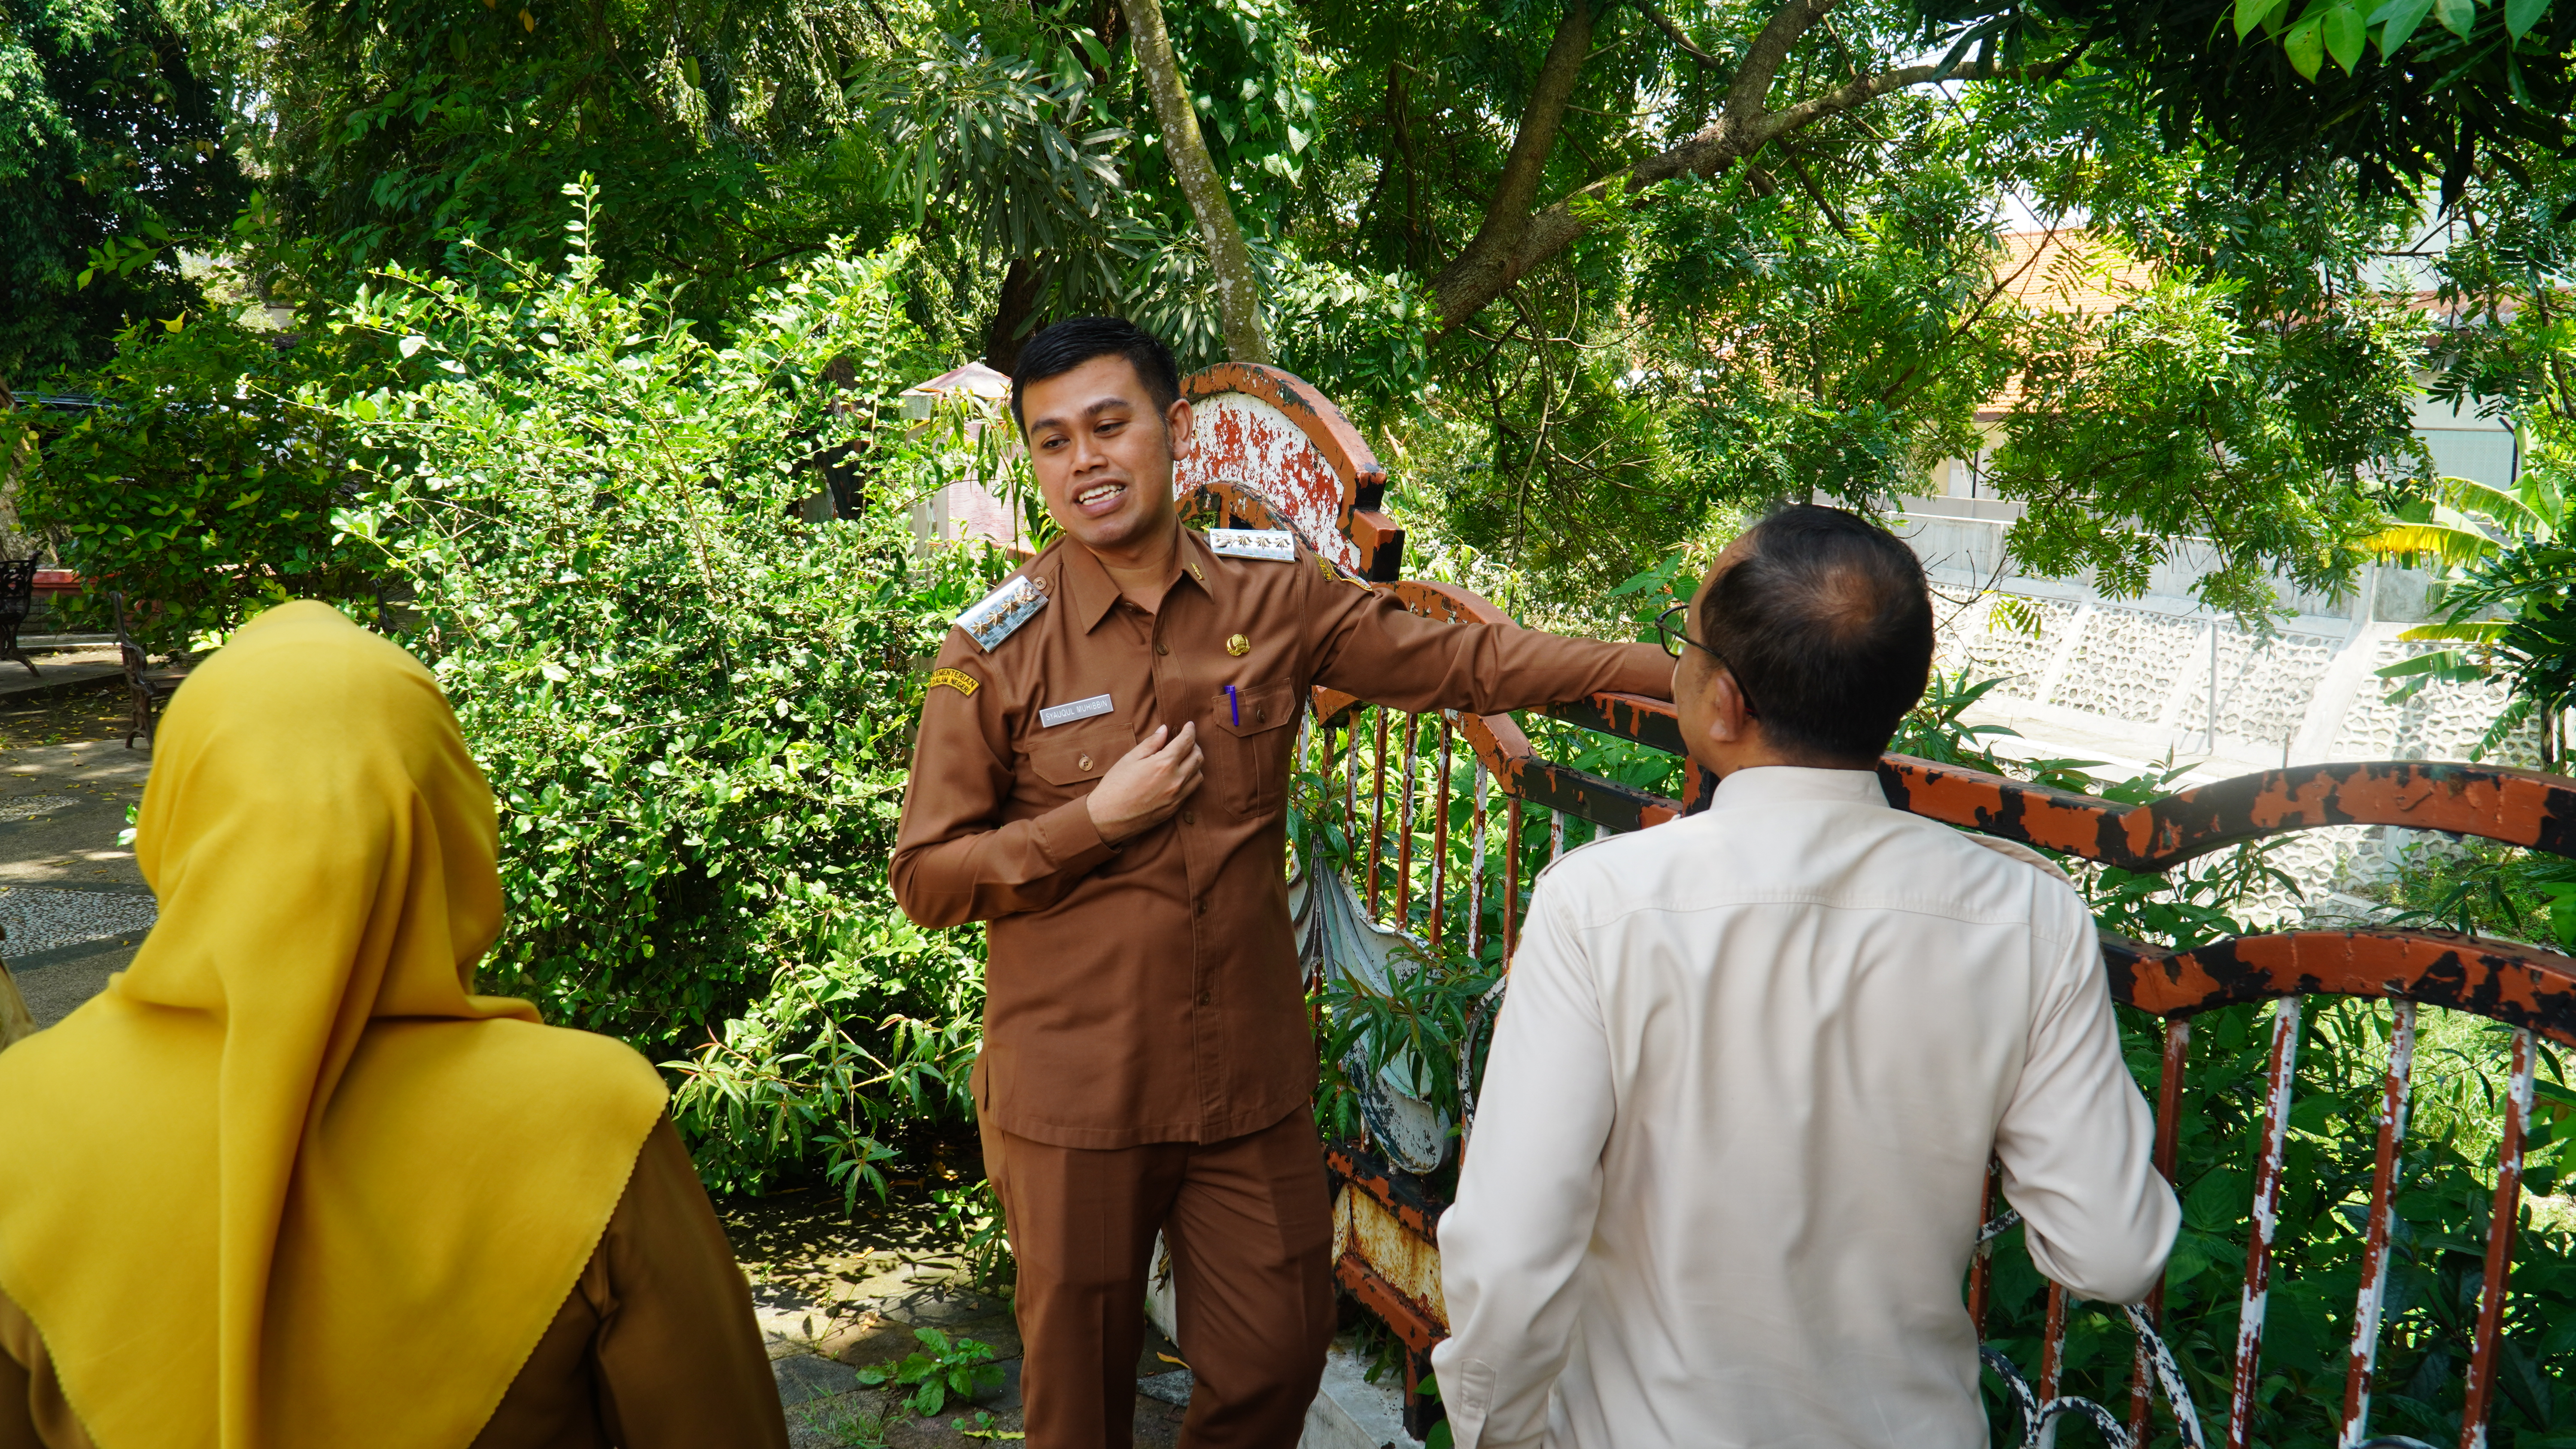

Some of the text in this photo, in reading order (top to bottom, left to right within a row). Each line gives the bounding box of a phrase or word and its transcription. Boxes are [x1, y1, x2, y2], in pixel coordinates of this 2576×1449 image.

[932, 669, 976, 688] KEMENTERIAN
[932, 676, 970, 693] DALAM NEGERI
[1045, 700, 1107, 721] SYAUQUL MUHIBBIN
